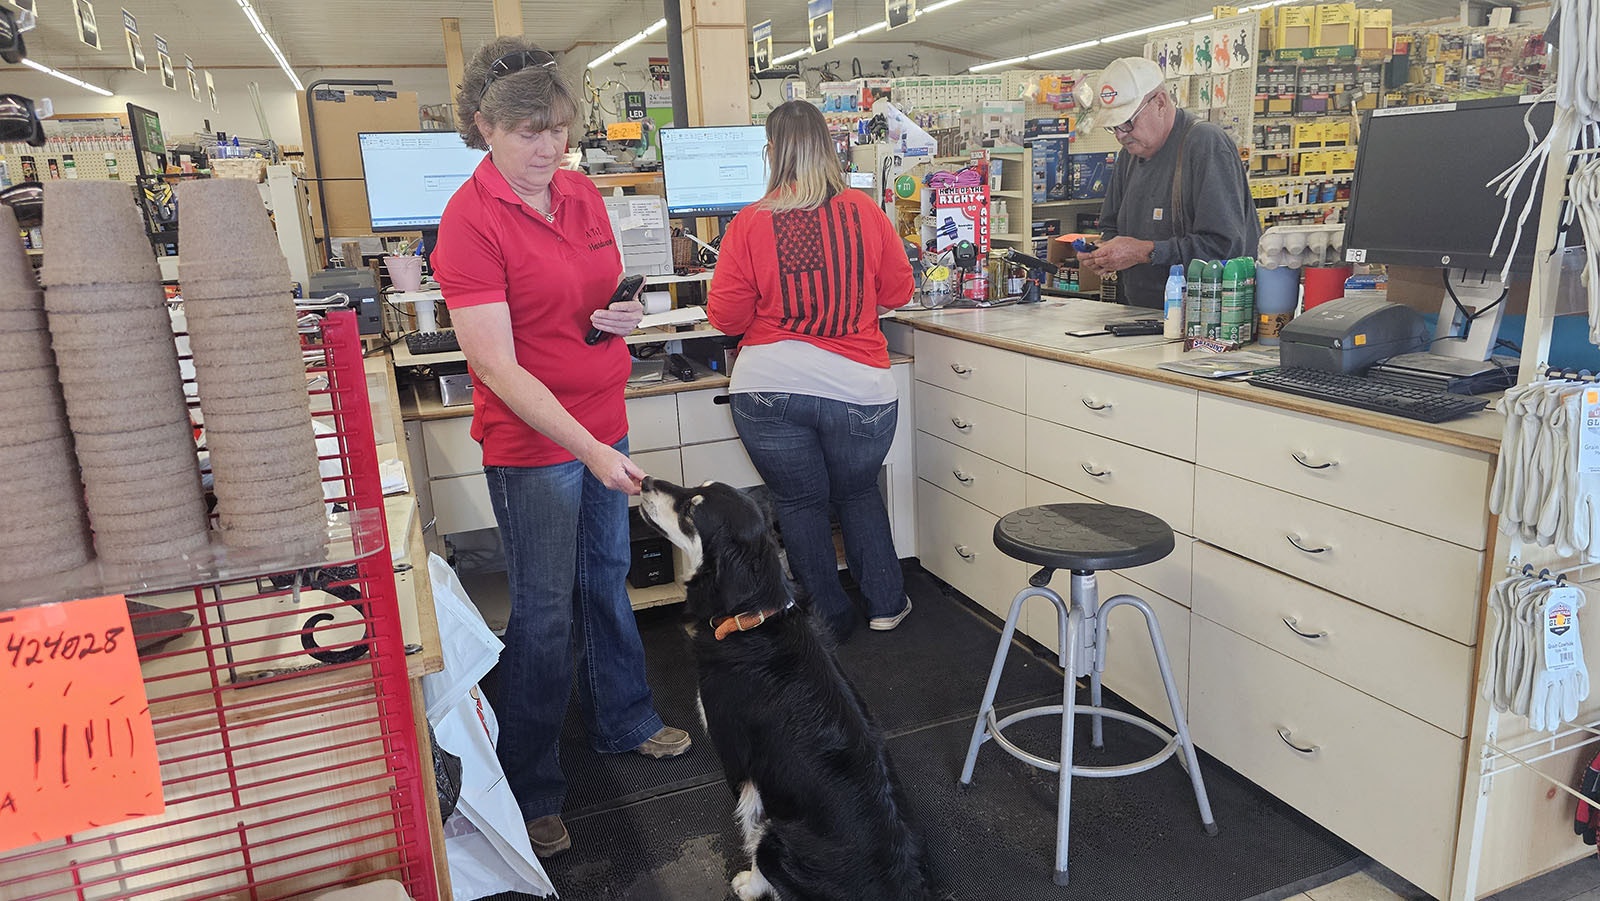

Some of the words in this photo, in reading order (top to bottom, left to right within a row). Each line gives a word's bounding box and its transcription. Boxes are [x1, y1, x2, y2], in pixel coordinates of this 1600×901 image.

[629, 110, 644, 118] LED
[938, 187, 958, 195] HOME
[938, 194, 975, 205] RIGHT
[980, 207, 988, 254] ANGLE
[1548, 617, 1572, 627] GLVE
[7, 626, 125, 667] 424028
